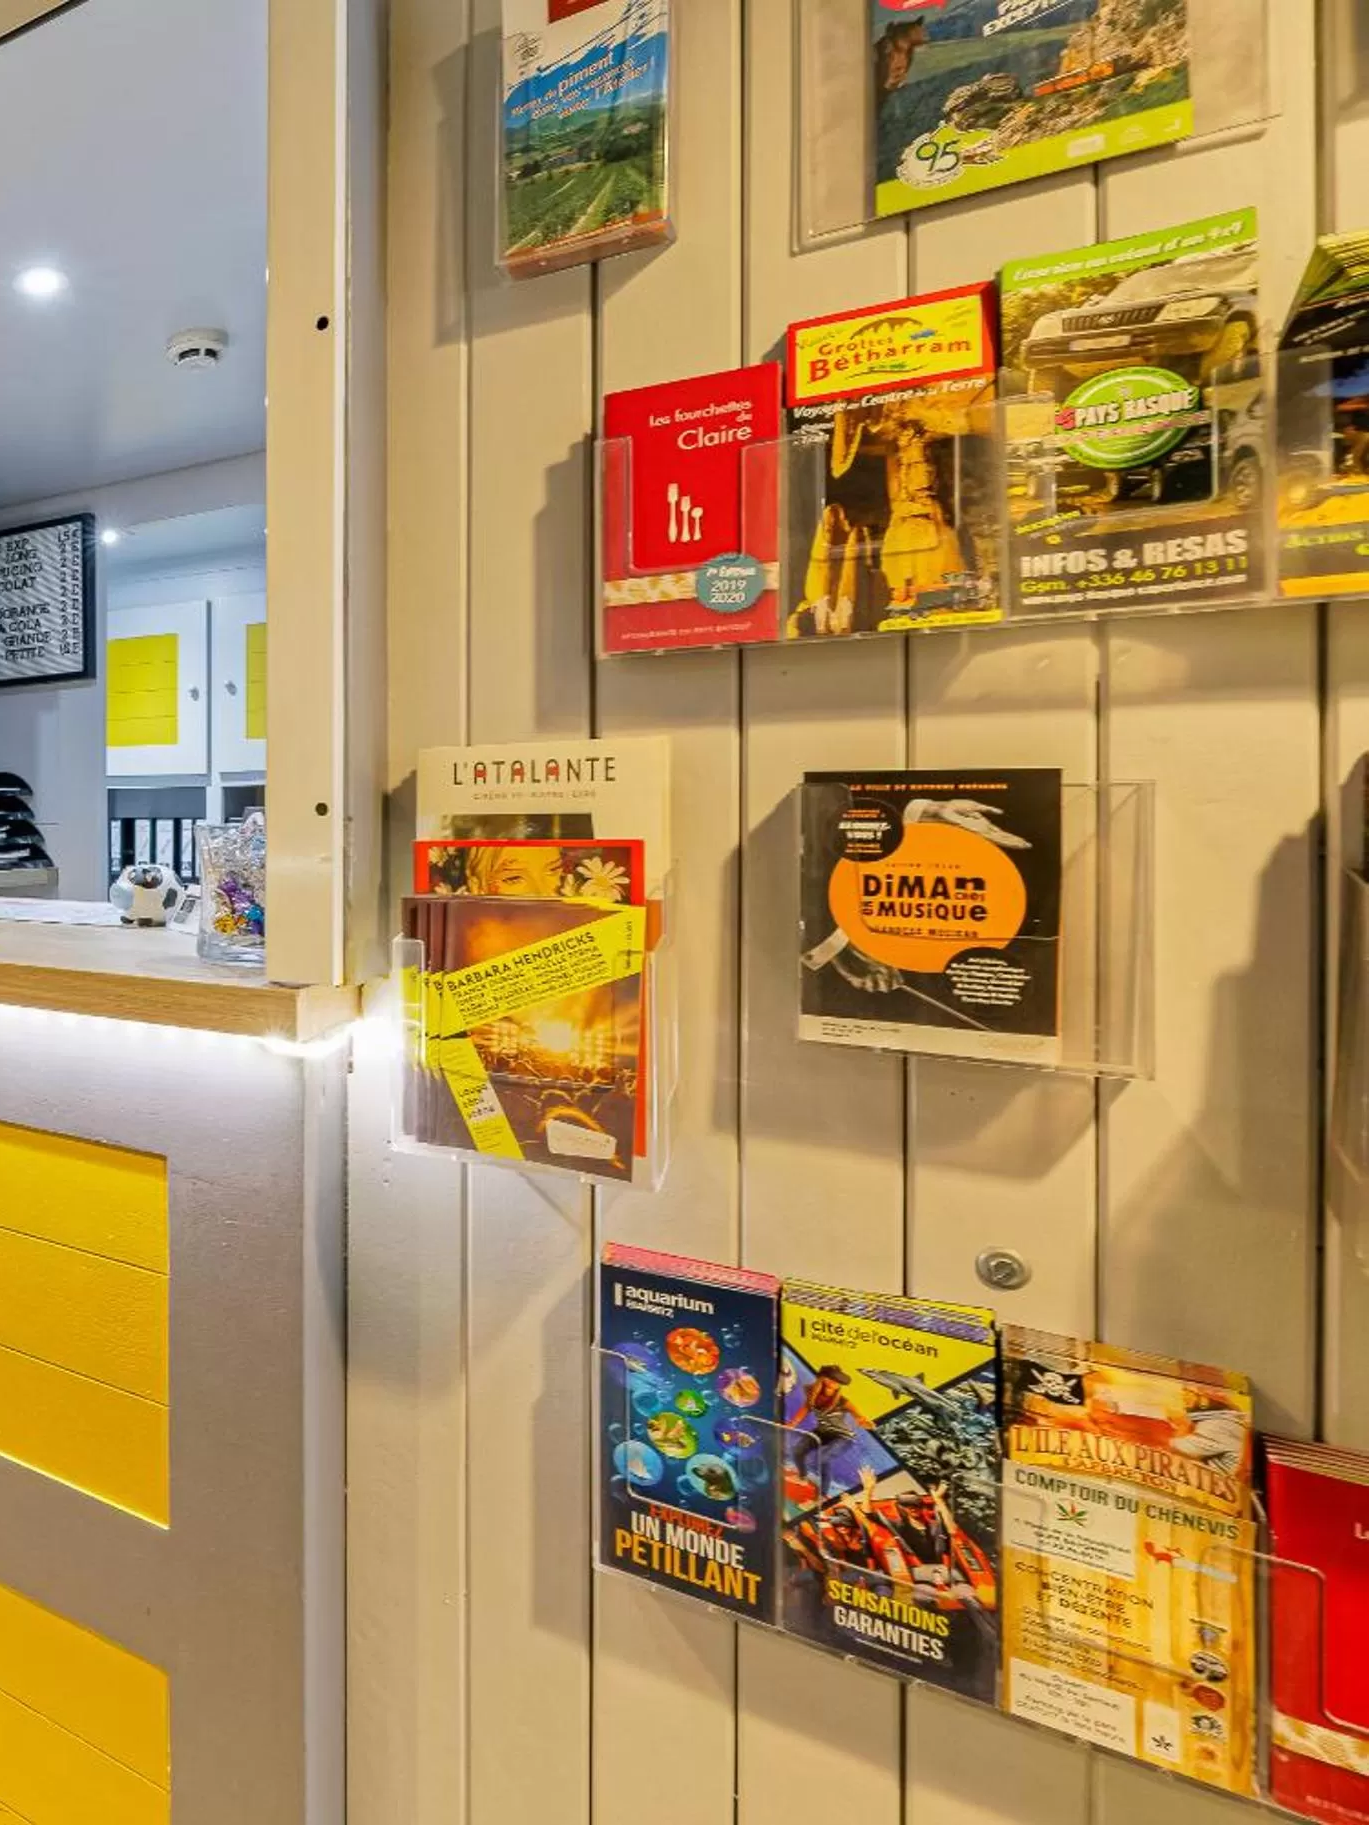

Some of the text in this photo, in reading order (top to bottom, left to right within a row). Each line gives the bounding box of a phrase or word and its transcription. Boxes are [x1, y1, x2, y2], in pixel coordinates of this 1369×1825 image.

[558, 50, 614, 98] piment
[915, 139, 961, 174] 95
[817, 336, 895, 356] Grottes
[648, 399, 753, 428] Les fourchettes
[793, 400, 847, 421] Voyage
[861, 388, 915, 408] Centre
[941, 377, 988, 395] Terre
[1074, 387, 1197, 428] PAYS BASQUE
[735, 411, 753, 423] de
[677, 424, 753, 450] Claire
[1112, 548, 1138, 569] &
[1142, 529, 1248, 566] RESAS
[710, 579, 748, 594] 2019
[1076, 573, 1126, 589] +336
[1130, 569, 1156, 583] 46
[1162, 565, 1188, 580] 76
[1194, 560, 1220, 576] 13
[1226, 555, 1248, 571] 11
[709, 592, 746, 605] 2020
[9, 618, 42, 633] COLA
[452, 756, 617, 786] L'ATALANTE
[446, 963, 512, 992] BARBARA
[513, 931, 596, 970] HENDRICKS
[625, 1285, 716, 1315] aquarium
[1079, 1430, 1129, 1467] AUX
[1134, 1446, 1240, 1505] PIRATES
[1014, 1467, 1110, 1507] COMPTOIR
[1113, 1493, 1140, 1515] DU
[631, 1510, 746, 1571] UN MONDE
[826, 1578, 951, 1638] SENSATIONS
[832, 1604, 946, 1661] GARANTIES
